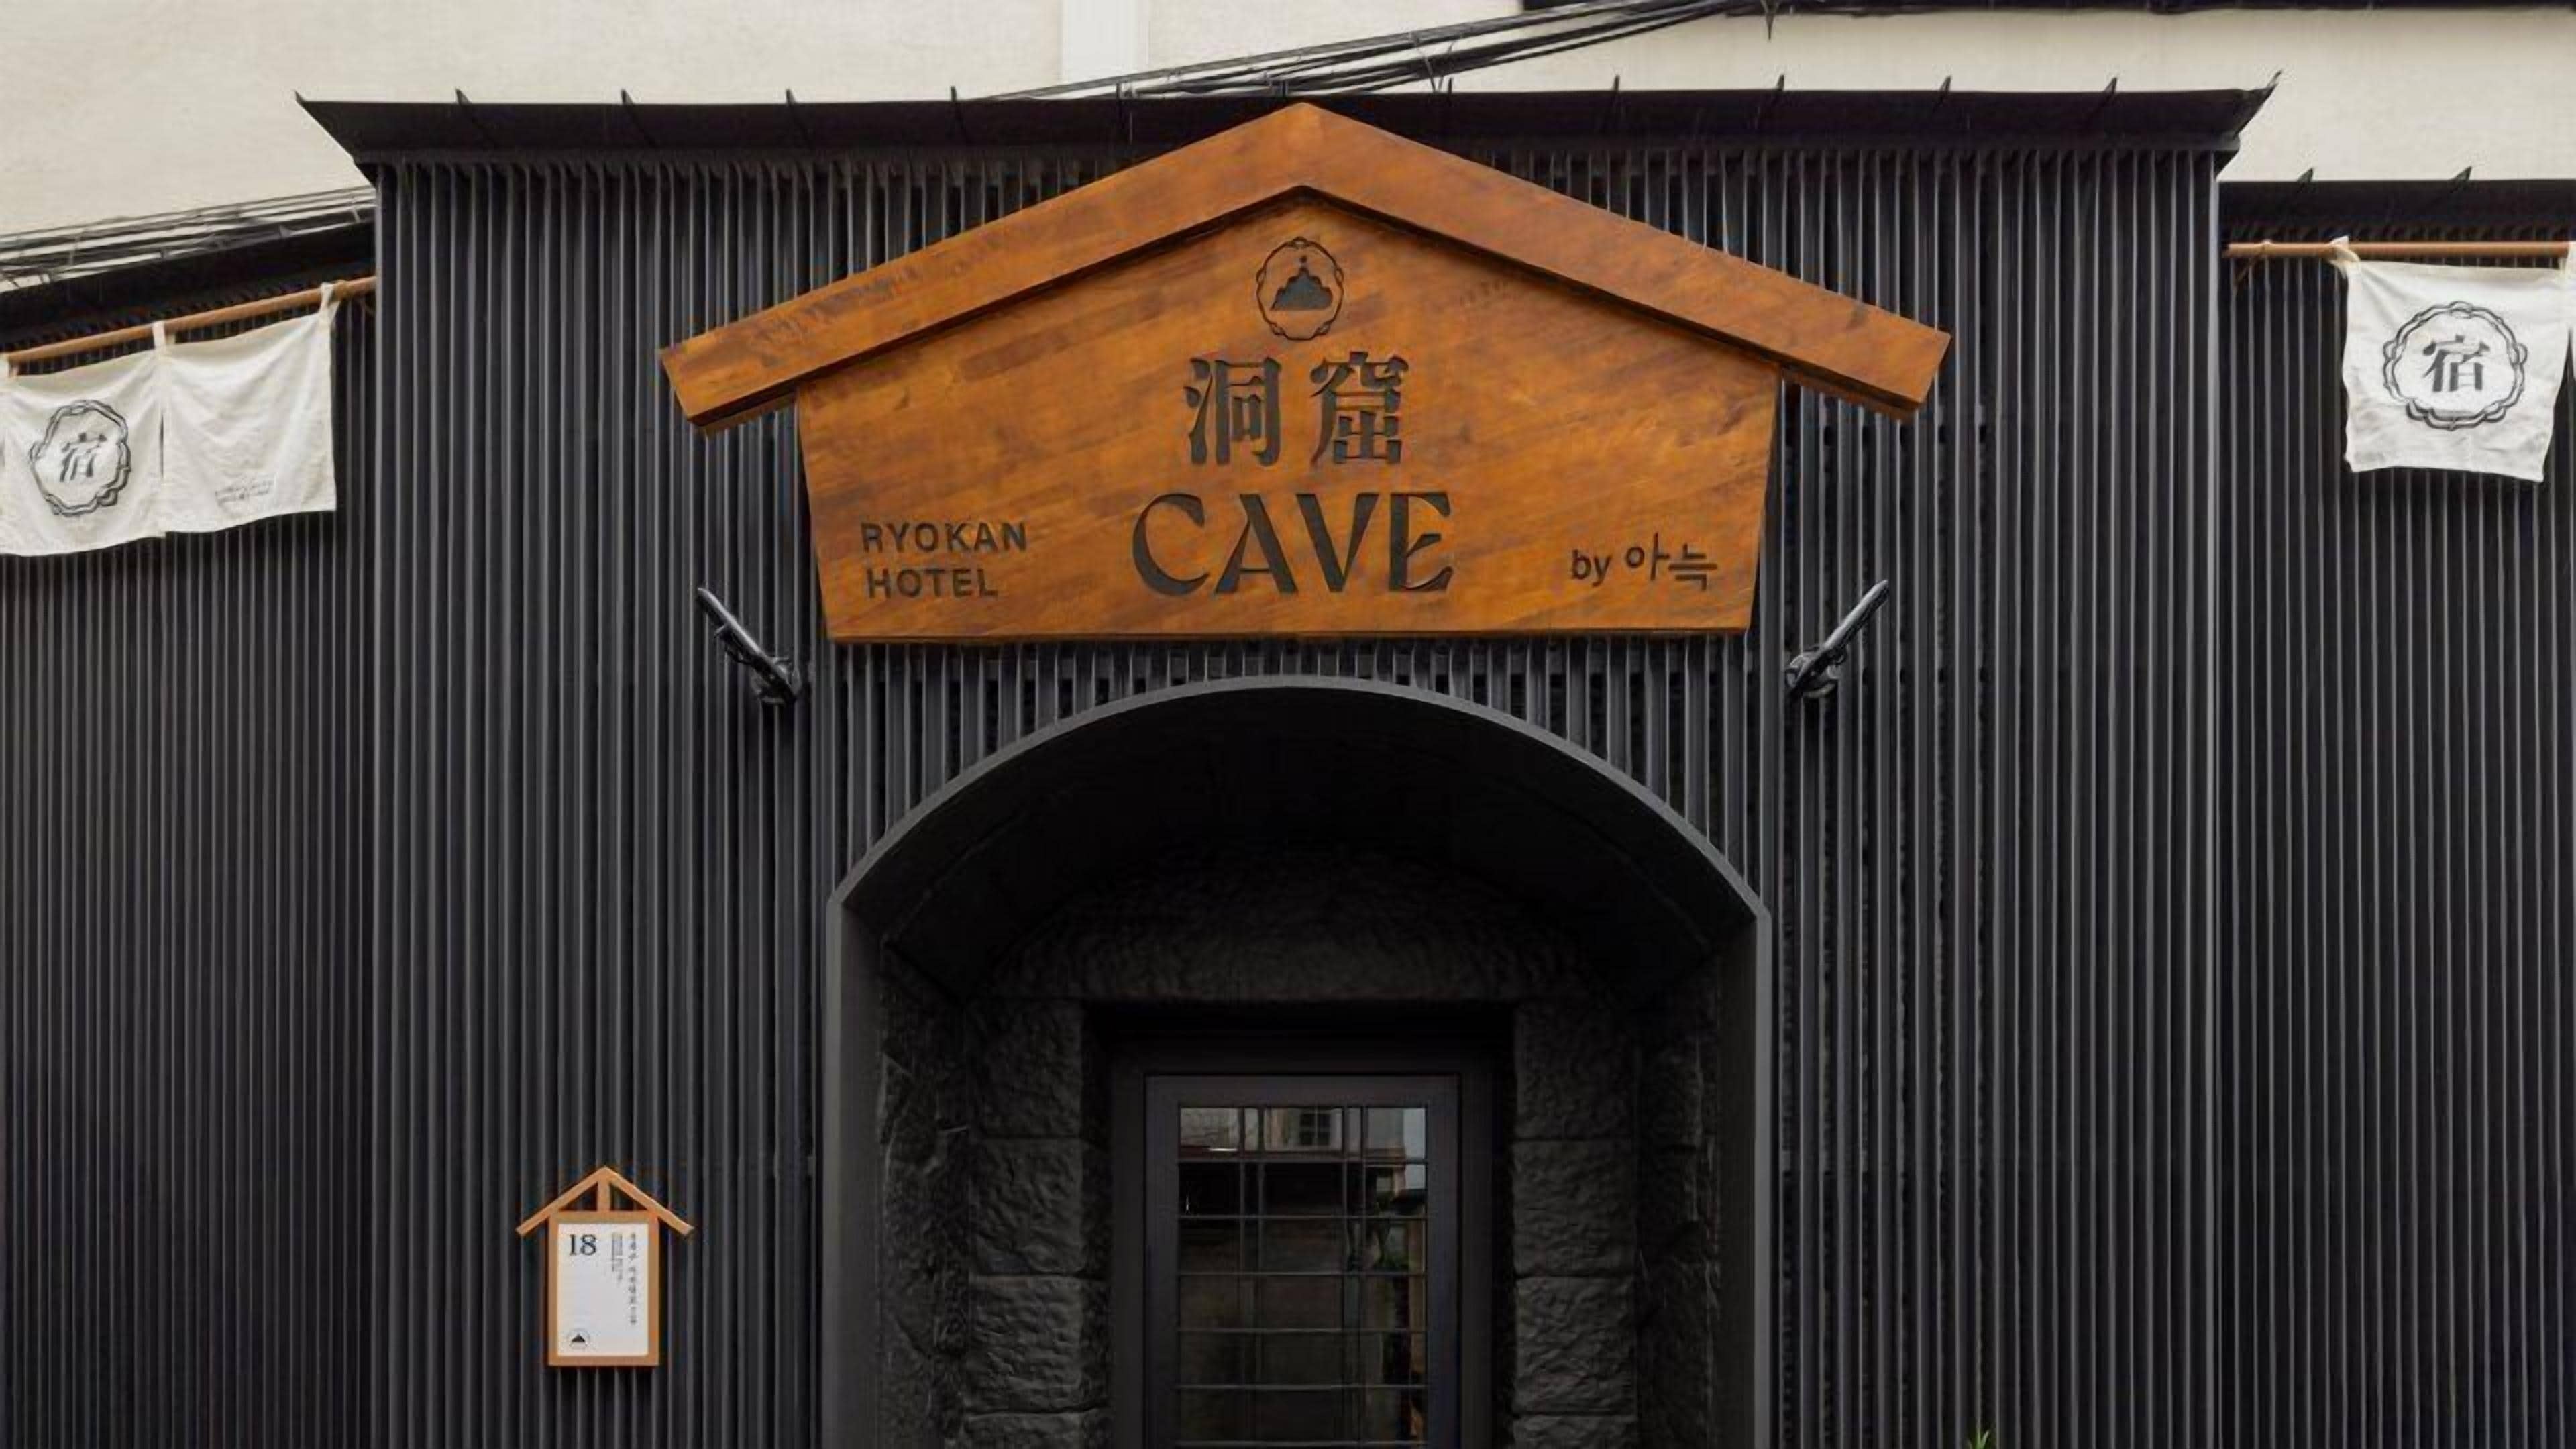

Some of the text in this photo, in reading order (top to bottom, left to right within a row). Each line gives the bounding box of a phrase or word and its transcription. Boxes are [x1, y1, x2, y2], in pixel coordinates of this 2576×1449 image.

[2422, 334, 2491, 392] 宿
[1183, 351, 1409, 467] 洞窟
[861, 521, 1027, 553] RYOKAN
[1132, 492, 1454, 596] CAVE
[1571, 531, 1718, 592] by 아늑
[865, 568, 998, 599] HOTEL
[568, 1233, 597, 1256] 18
